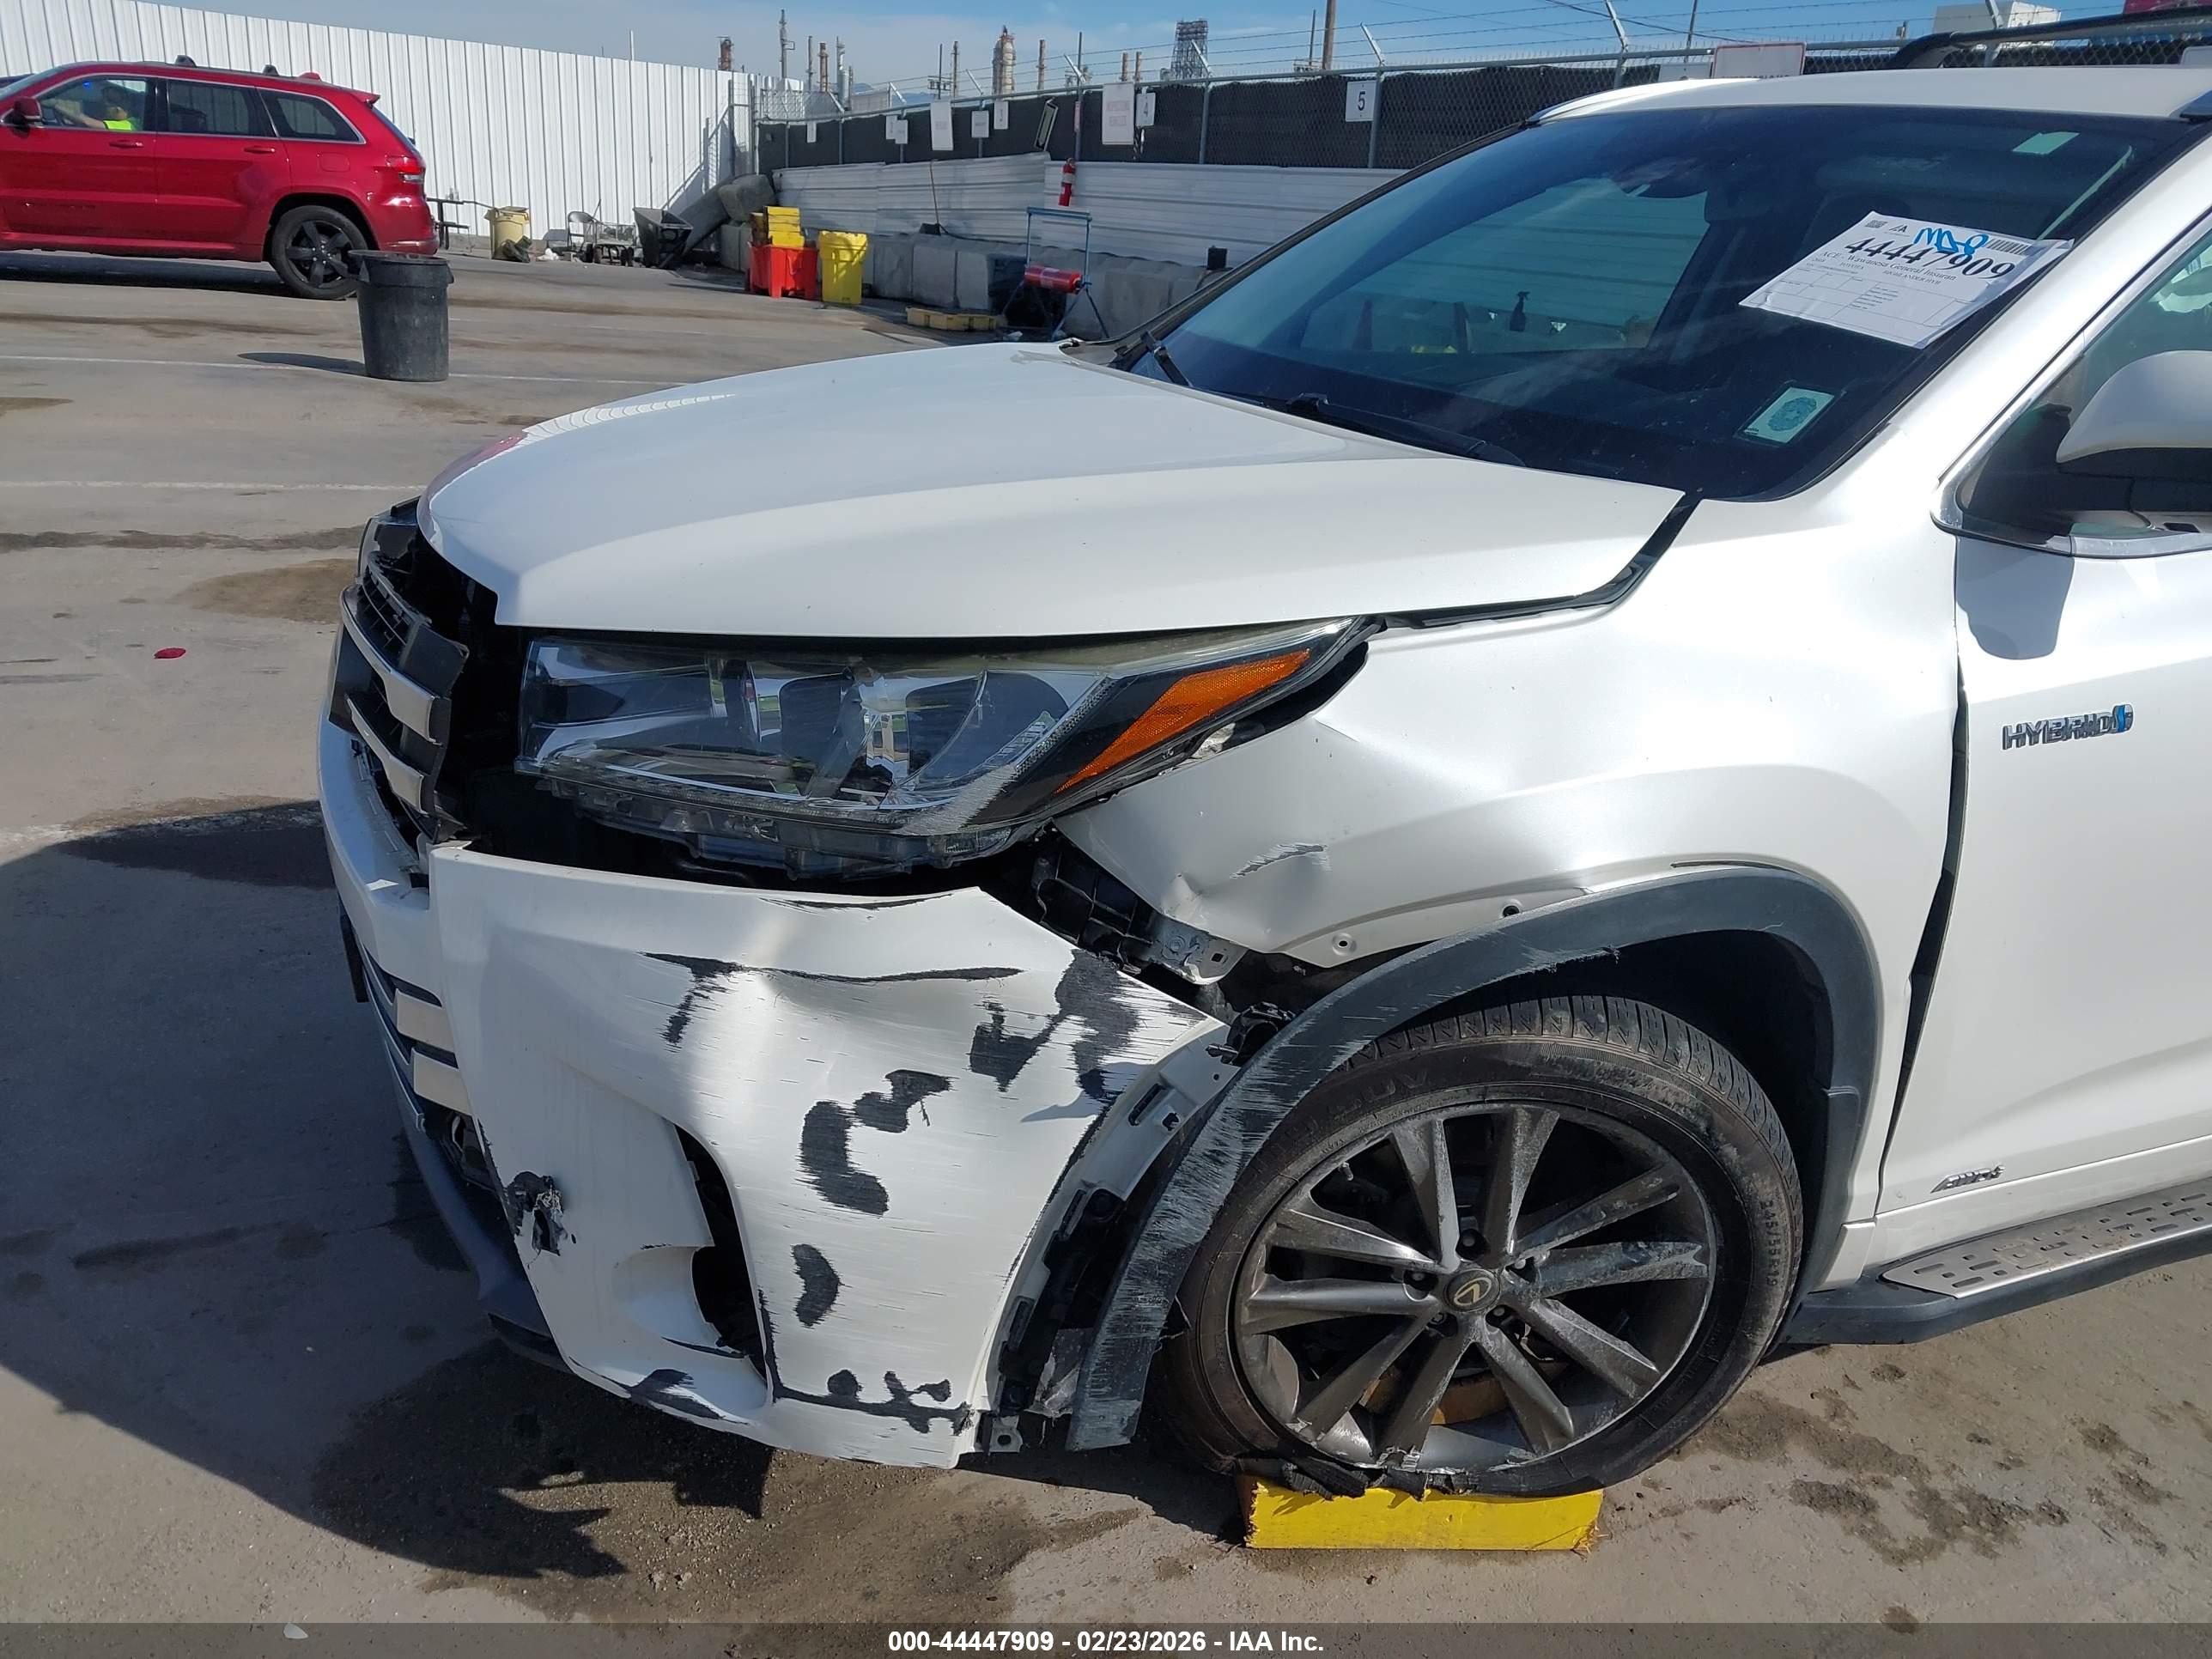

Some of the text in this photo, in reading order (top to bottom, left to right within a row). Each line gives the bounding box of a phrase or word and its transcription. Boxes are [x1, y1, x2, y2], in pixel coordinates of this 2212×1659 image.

[1357, 90, 1366, 111] 5
[1844, 237, 2016, 280] 44447909
[1890, 262, 1925, 274] General
[2002, 711, 2116, 750] HYBRID
